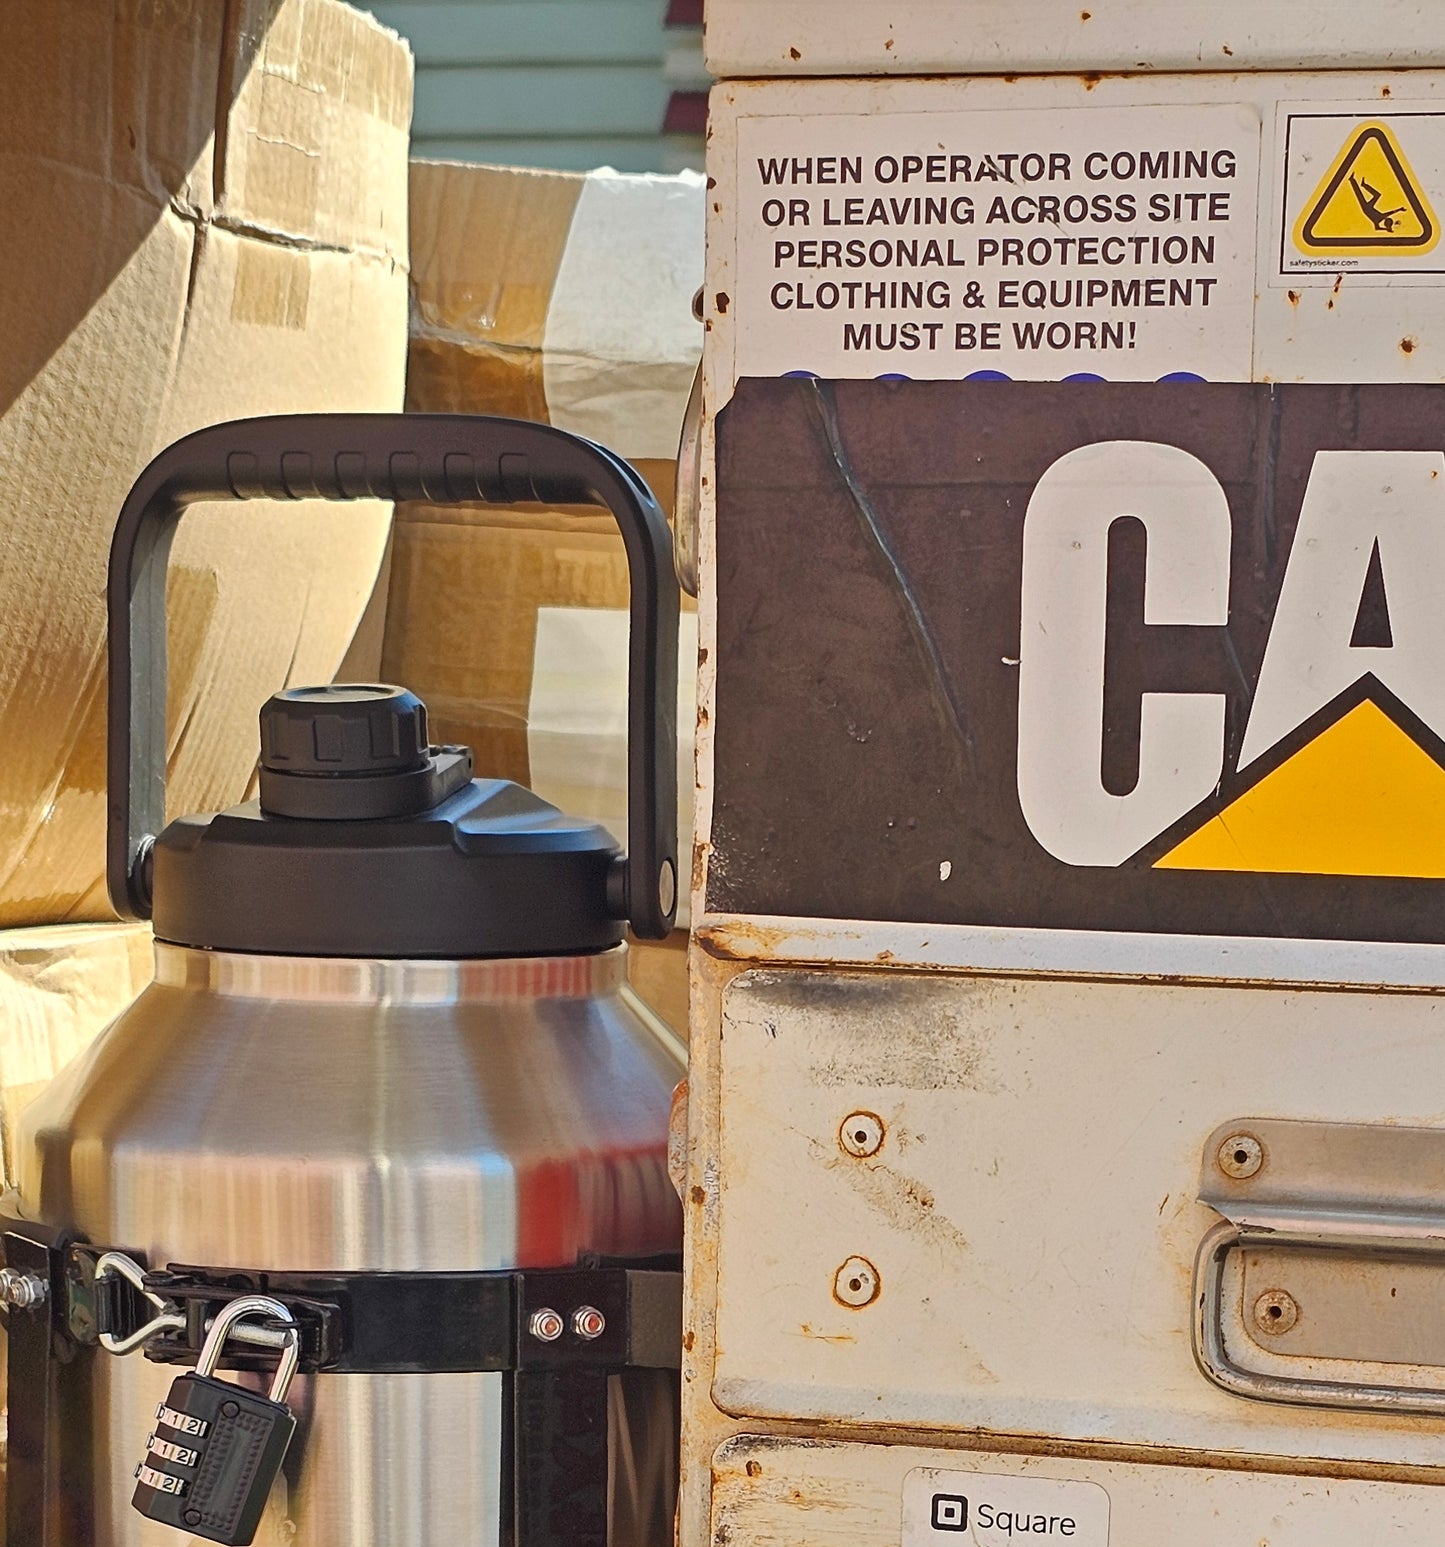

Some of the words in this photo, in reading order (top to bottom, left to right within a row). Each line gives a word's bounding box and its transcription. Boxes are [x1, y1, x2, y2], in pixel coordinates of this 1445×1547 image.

[757, 156, 863, 185] WHEN
[874, 152, 1072, 184] OPERATOR
[1084, 149, 1237, 181] COMING
[760, 199, 811, 227] OR
[823, 196, 976, 226] LEAVING
[985, 194, 1138, 224] ACROSS
[1147, 192, 1232, 222] SITE
[774, 239, 967, 269] PERSONAL
[977, 236, 1216, 267] PROTECTION
[1289, 259, 1359, 268] safetysticker.com
[770, 280, 951, 310] CLOTHING
[962, 280, 987, 309] &
[998, 278, 1219, 310] EQUIPMENT
[843, 322, 945, 351] MUST
[954, 322, 1002, 351] BE
[1012, 321, 1137, 350] WORN!
[977, 1503, 1076, 1537] Square
